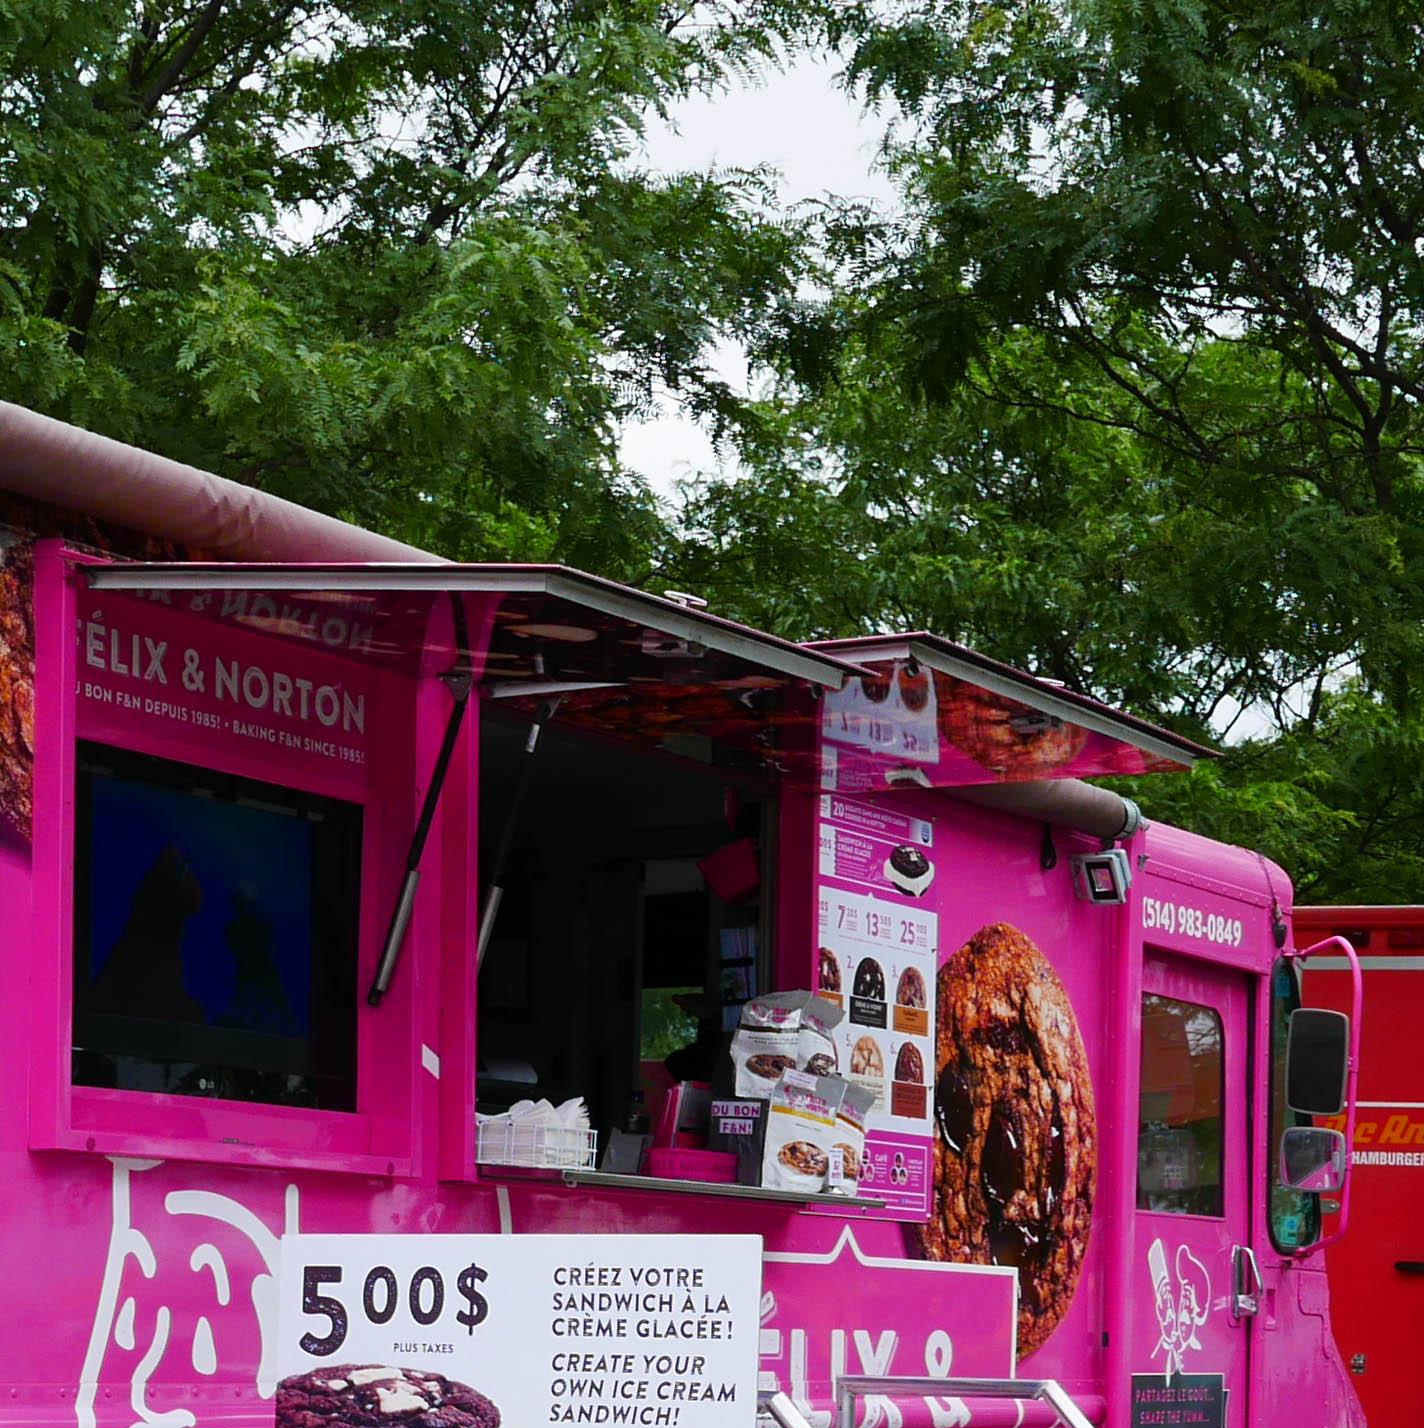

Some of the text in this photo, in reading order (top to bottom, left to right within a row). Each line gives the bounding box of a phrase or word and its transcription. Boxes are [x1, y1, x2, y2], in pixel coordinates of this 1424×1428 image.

[76, 610, 365, 735] ÉLIX & NORTON
[85, 683, 365, 765] BON F&N DEPUIS 1985! BAKING F&N SINCE 1985!
[900, 920, 915, 945] 25
[1143, 896, 1242, 947] (514) 983-0849
[712, 1104, 759, 1116] DU BON
[723, 1122, 751, 1134] F&N!
[553, 1262, 621, 1288] CRÉEZ
[629, 1267, 704, 1289] VOTRE
[552, 1289, 730, 1315] SANDWICH À LA
[552, 1313, 627, 1339] CRÈME
[393, 1342, 454, 1354] PLUS TAXES
[551, 1354, 705, 1376] CREATE YOUR
[550, 1379, 736, 1404] OWN ICE CREAM
[925, 1330, 971, 1428] &
[549, 1404, 681, 1427] SANDWICH!
